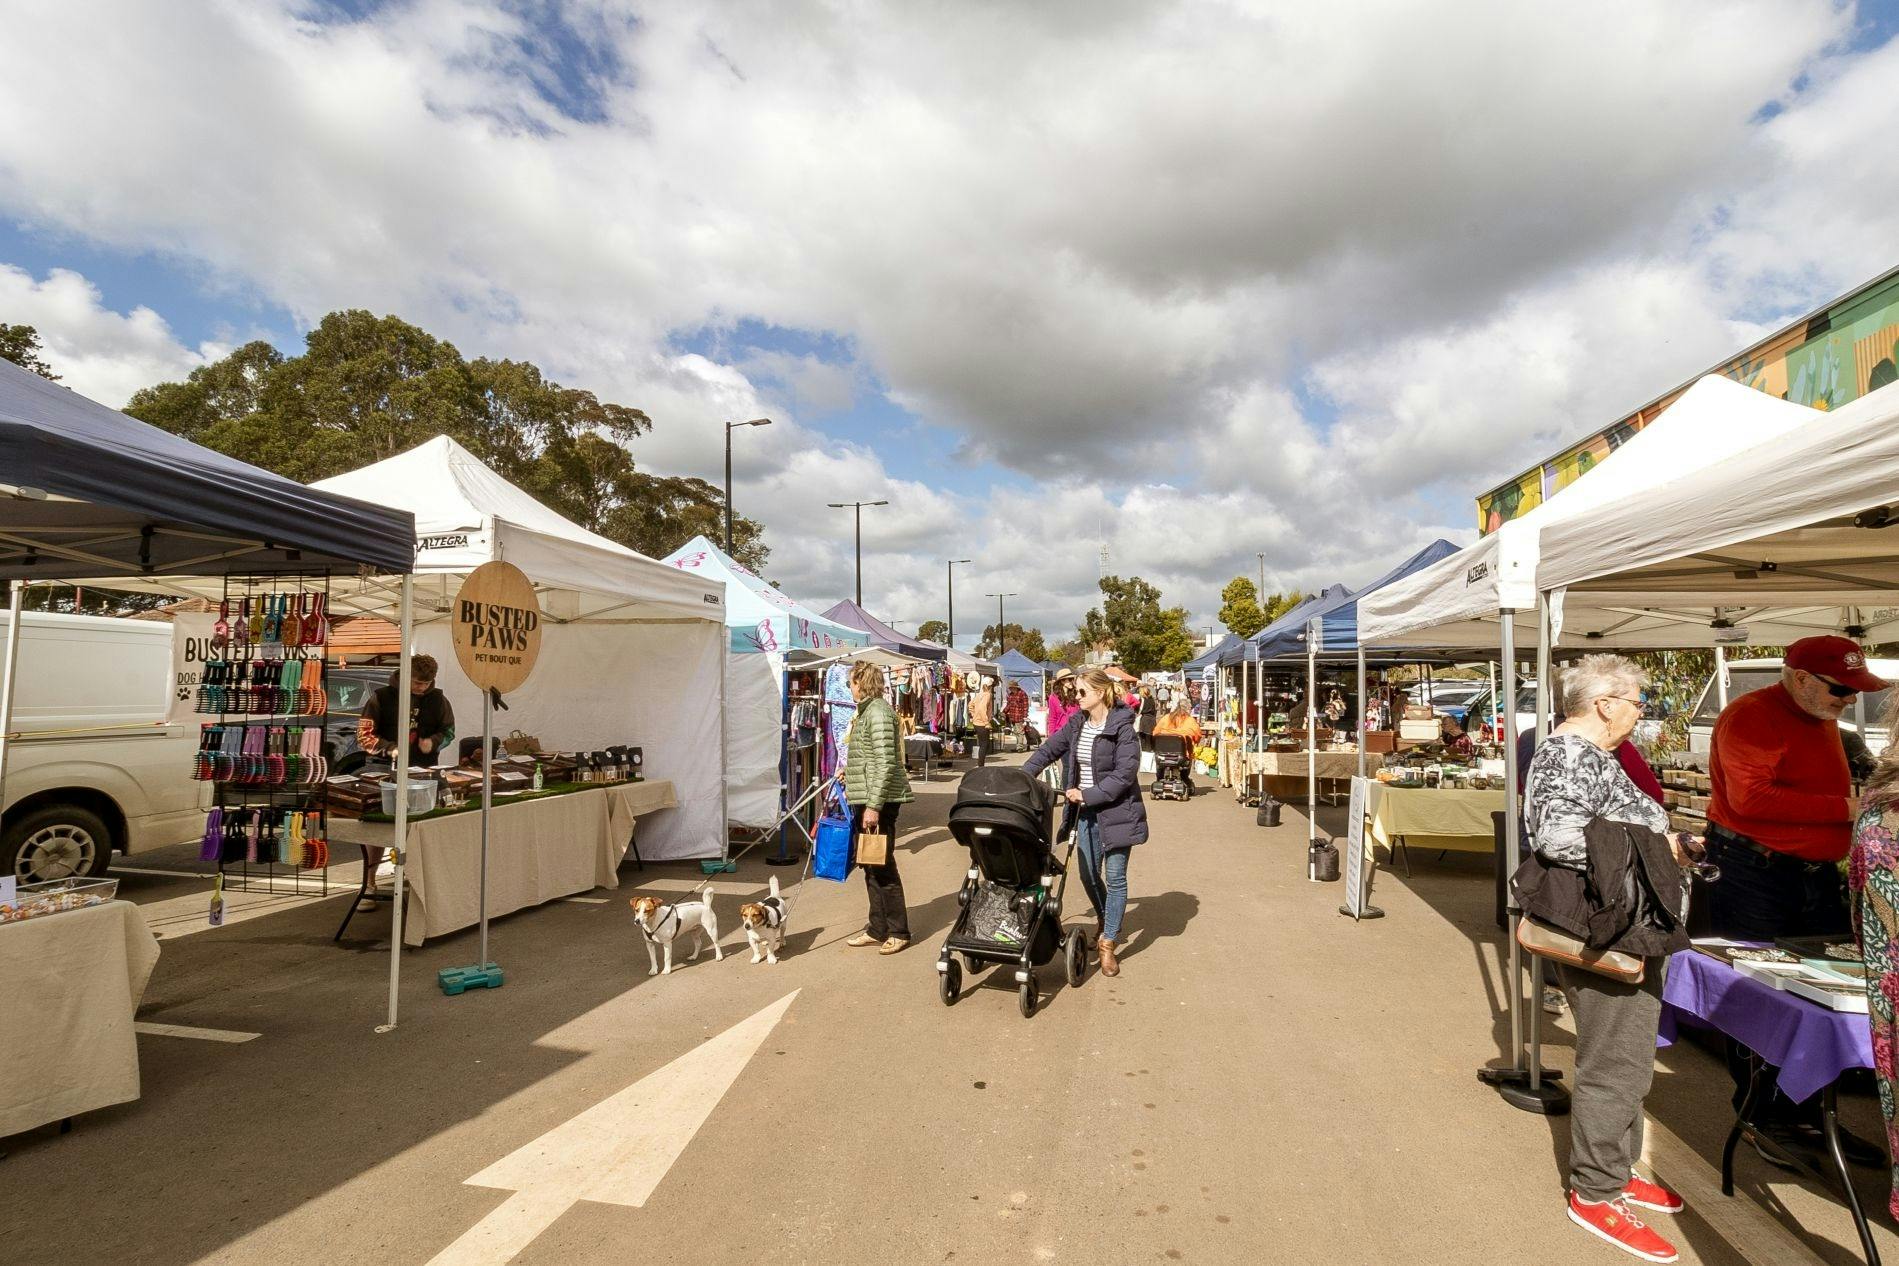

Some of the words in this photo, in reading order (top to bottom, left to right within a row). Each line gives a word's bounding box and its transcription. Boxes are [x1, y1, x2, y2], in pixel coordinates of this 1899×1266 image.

[417, 535, 468, 552] ALTEGRA
[460, 600, 538, 631] BUSTED
[471, 624, 527, 651] PAWS
[475, 653, 487, 662] PET
[177, 672, 196, 684] DOG
